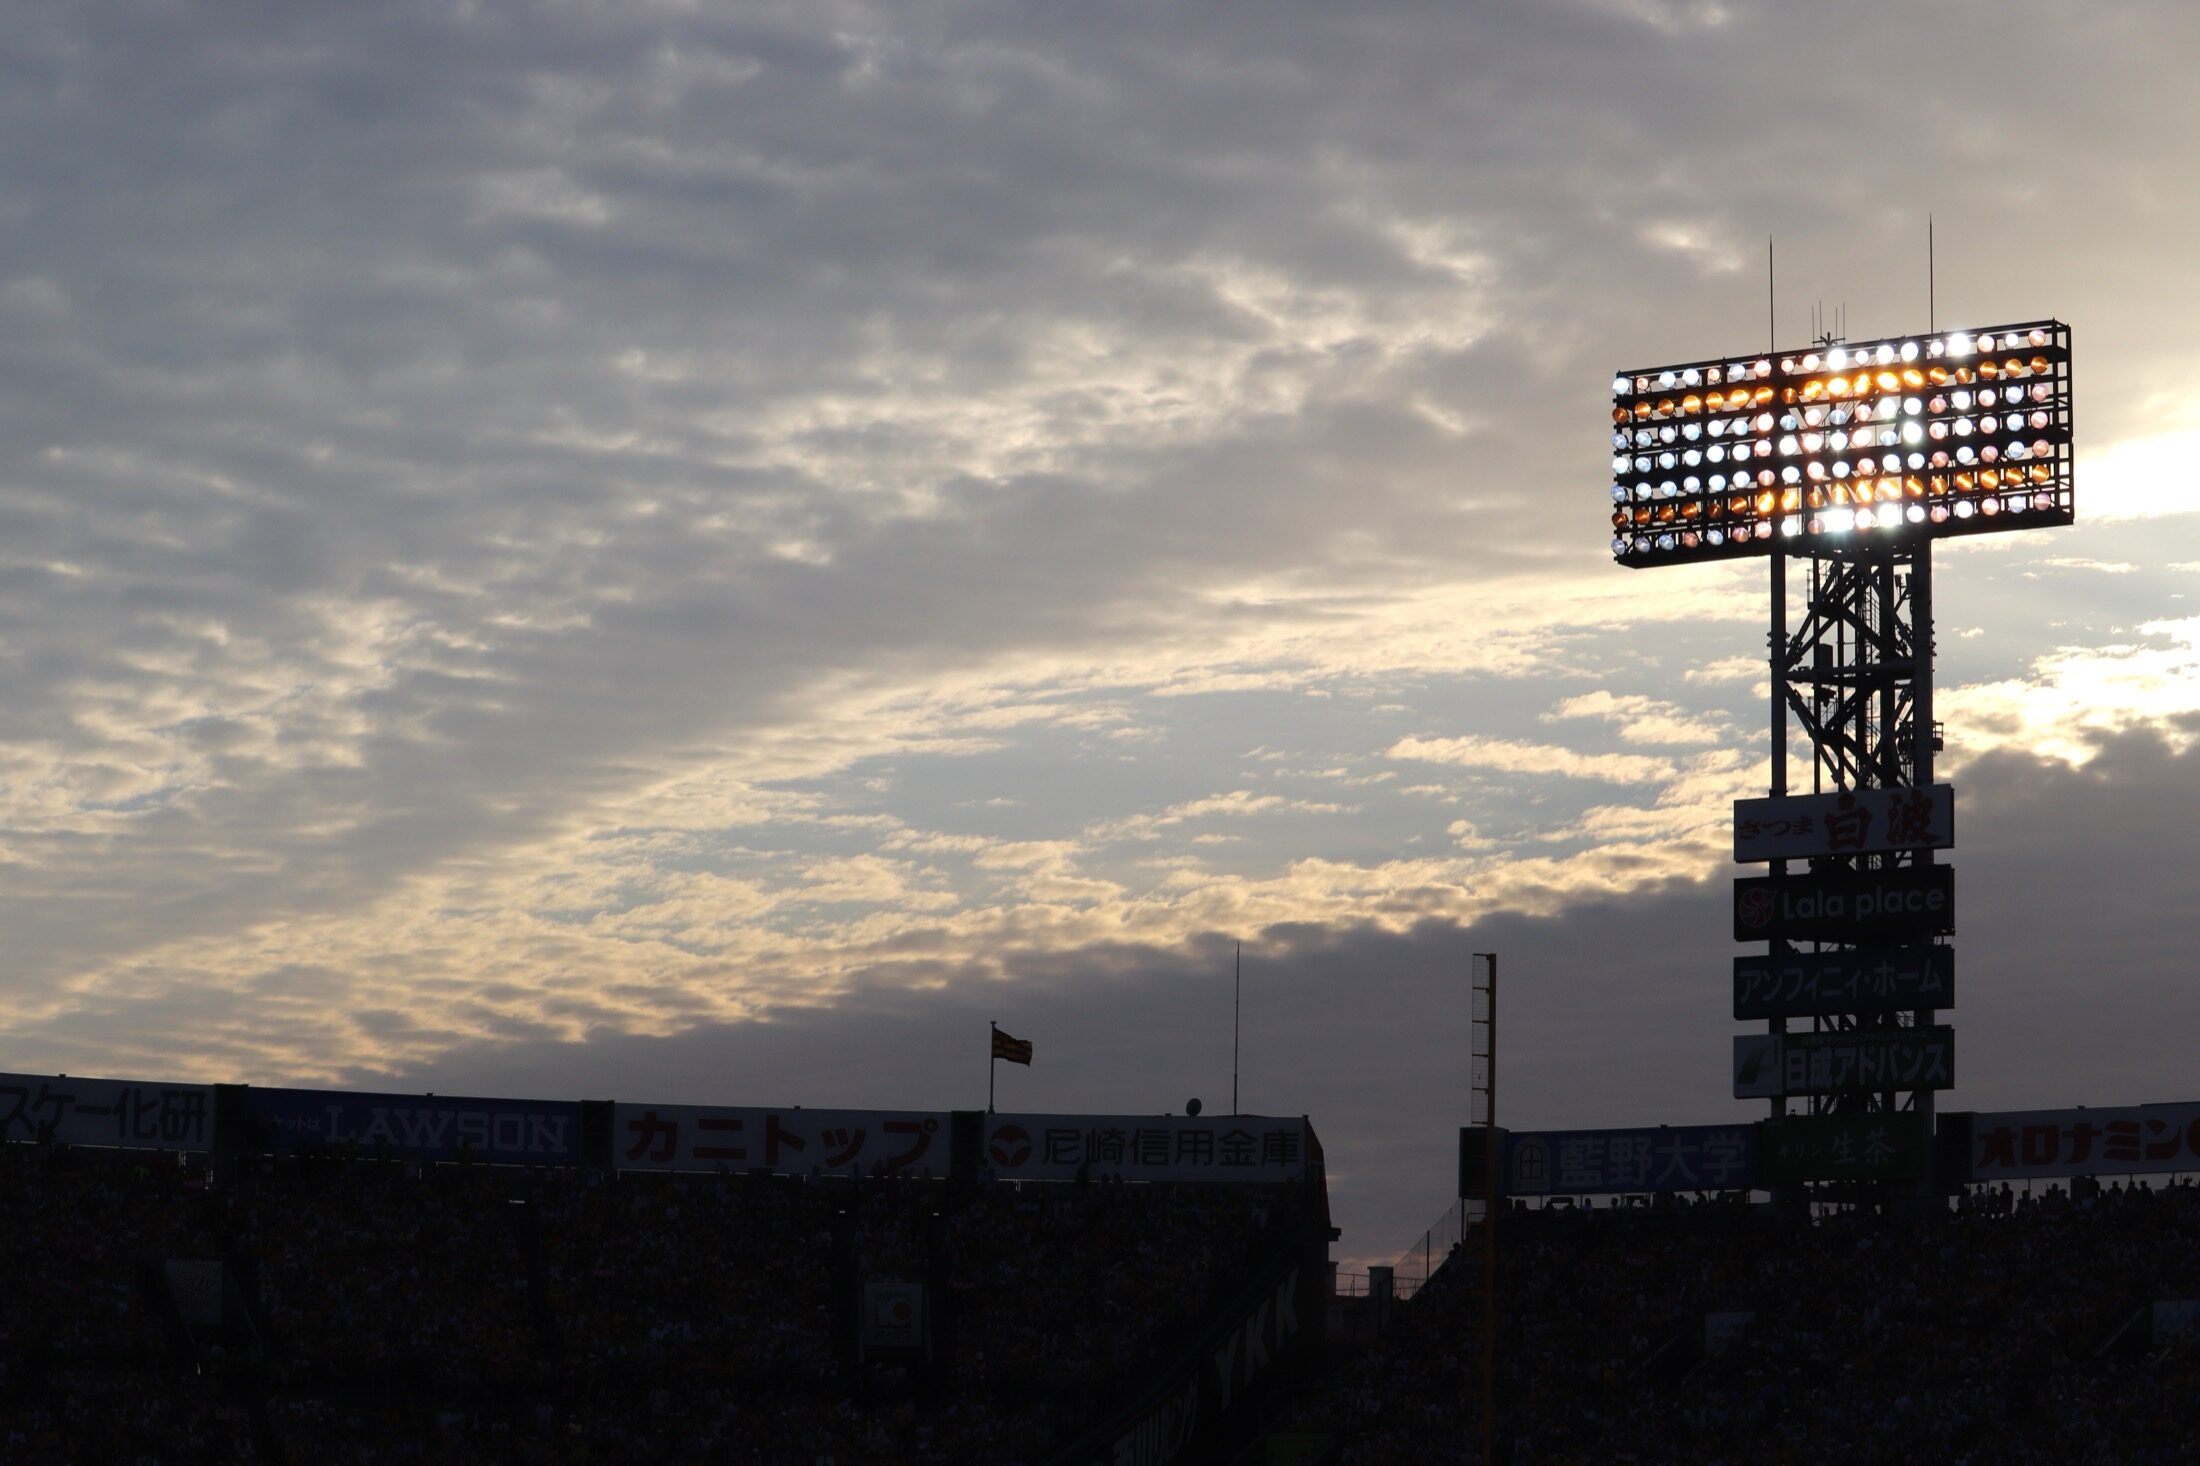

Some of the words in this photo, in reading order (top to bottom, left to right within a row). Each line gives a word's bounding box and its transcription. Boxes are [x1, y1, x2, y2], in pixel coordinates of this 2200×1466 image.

[1739, 815, 1813, 840] さつま
[1824, 791, 1942, 852] 白波
[1783, 888, 1844, 920] Lala
[1855, 884, 1945, 922] place
[325, 1104, 570, 1154] LAWSON
[626, 1111, 939, 1169] カニトップ
[1043, 1127, 1300, 1167] 尼崎信用金庫
[1777, 1142, 1823, 1160] キリン
[1831, 1126, 1897, 1166] 生茶
[1557, 1131, 1746, 1188] 藍野大学
[1214, 1267, 1299, 1412] YKK
